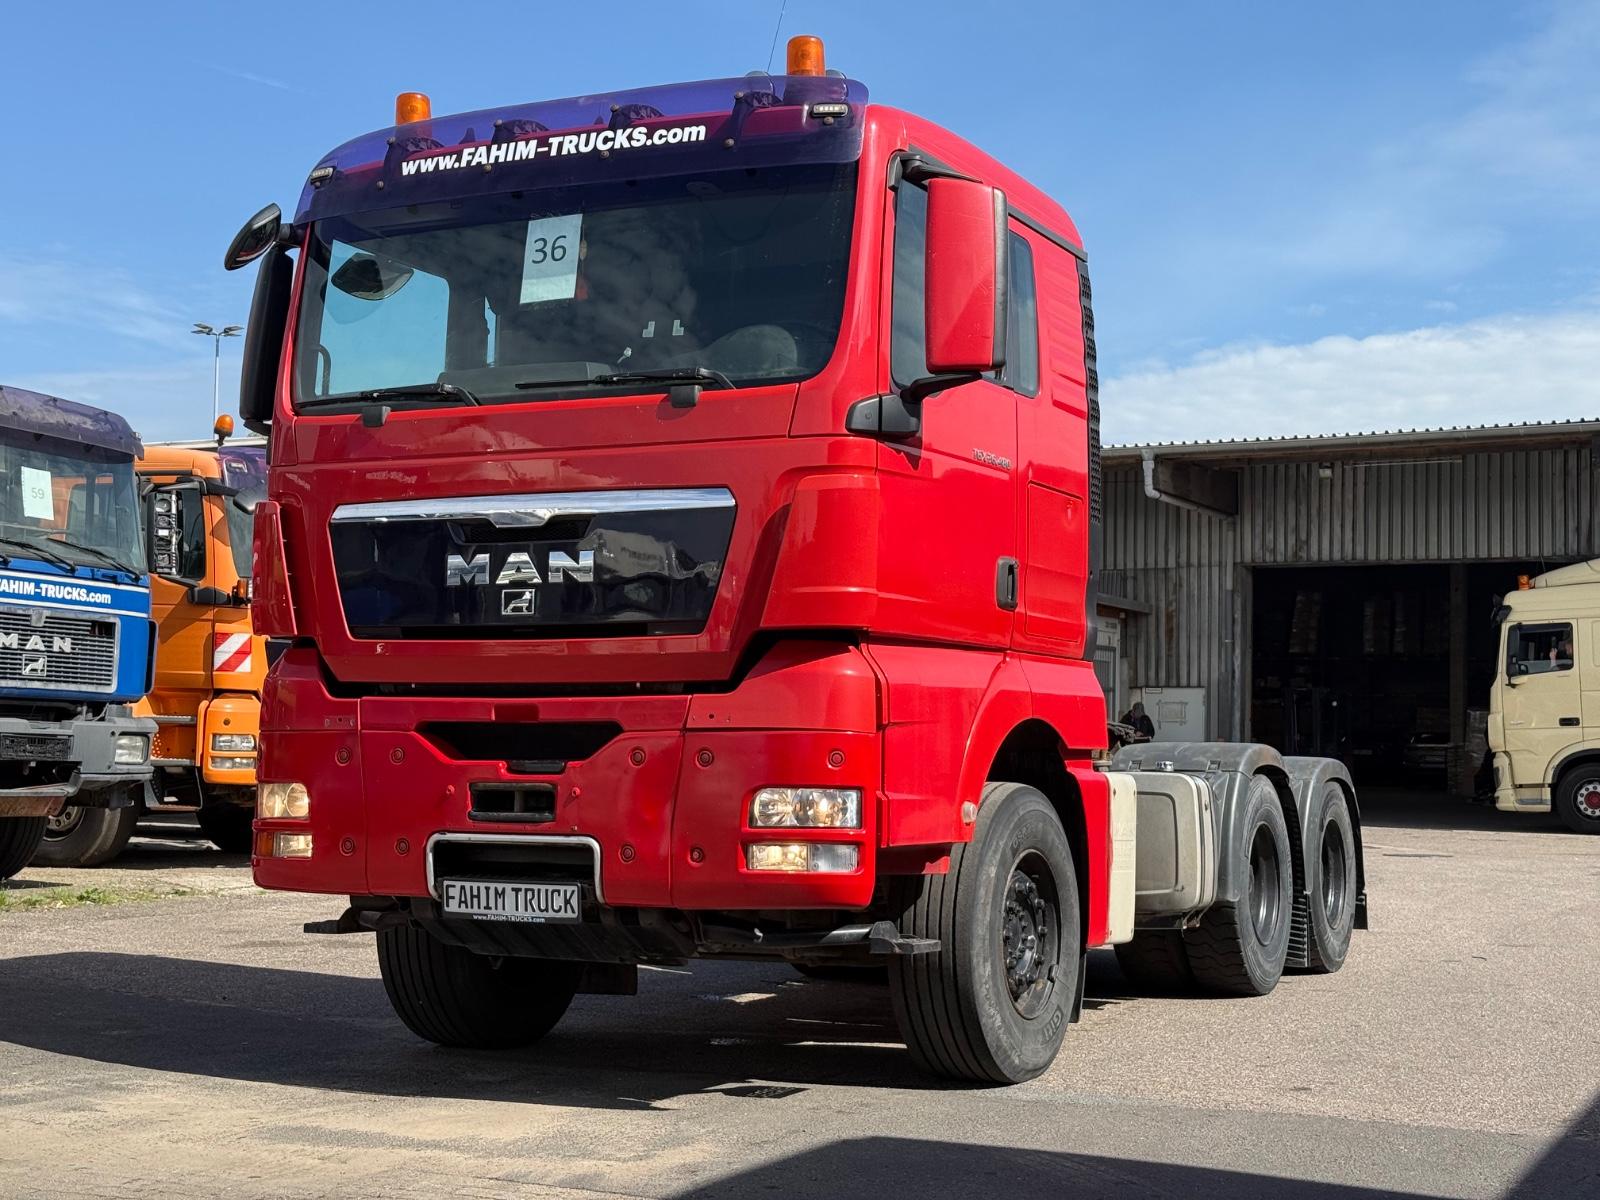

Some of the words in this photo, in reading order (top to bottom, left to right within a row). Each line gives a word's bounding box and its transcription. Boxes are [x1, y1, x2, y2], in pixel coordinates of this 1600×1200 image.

[401, 124, 706, 176] www.FAHIM-TRUCKS.com
[531, 234, 567, 264] 36
[31, 487, 45, 500] 59
[446, 550, 595, 586] MAN
[0, 578, 112, 604] AHIM-TRUCKS.com
[0, 632, 72, 653] MAN
[445, 884, 506, 911] FAHIM
[511, 887, 576, 914] TRUCK
[473, 914, 545, 923] www.FAHIM-TRUCKS.com
